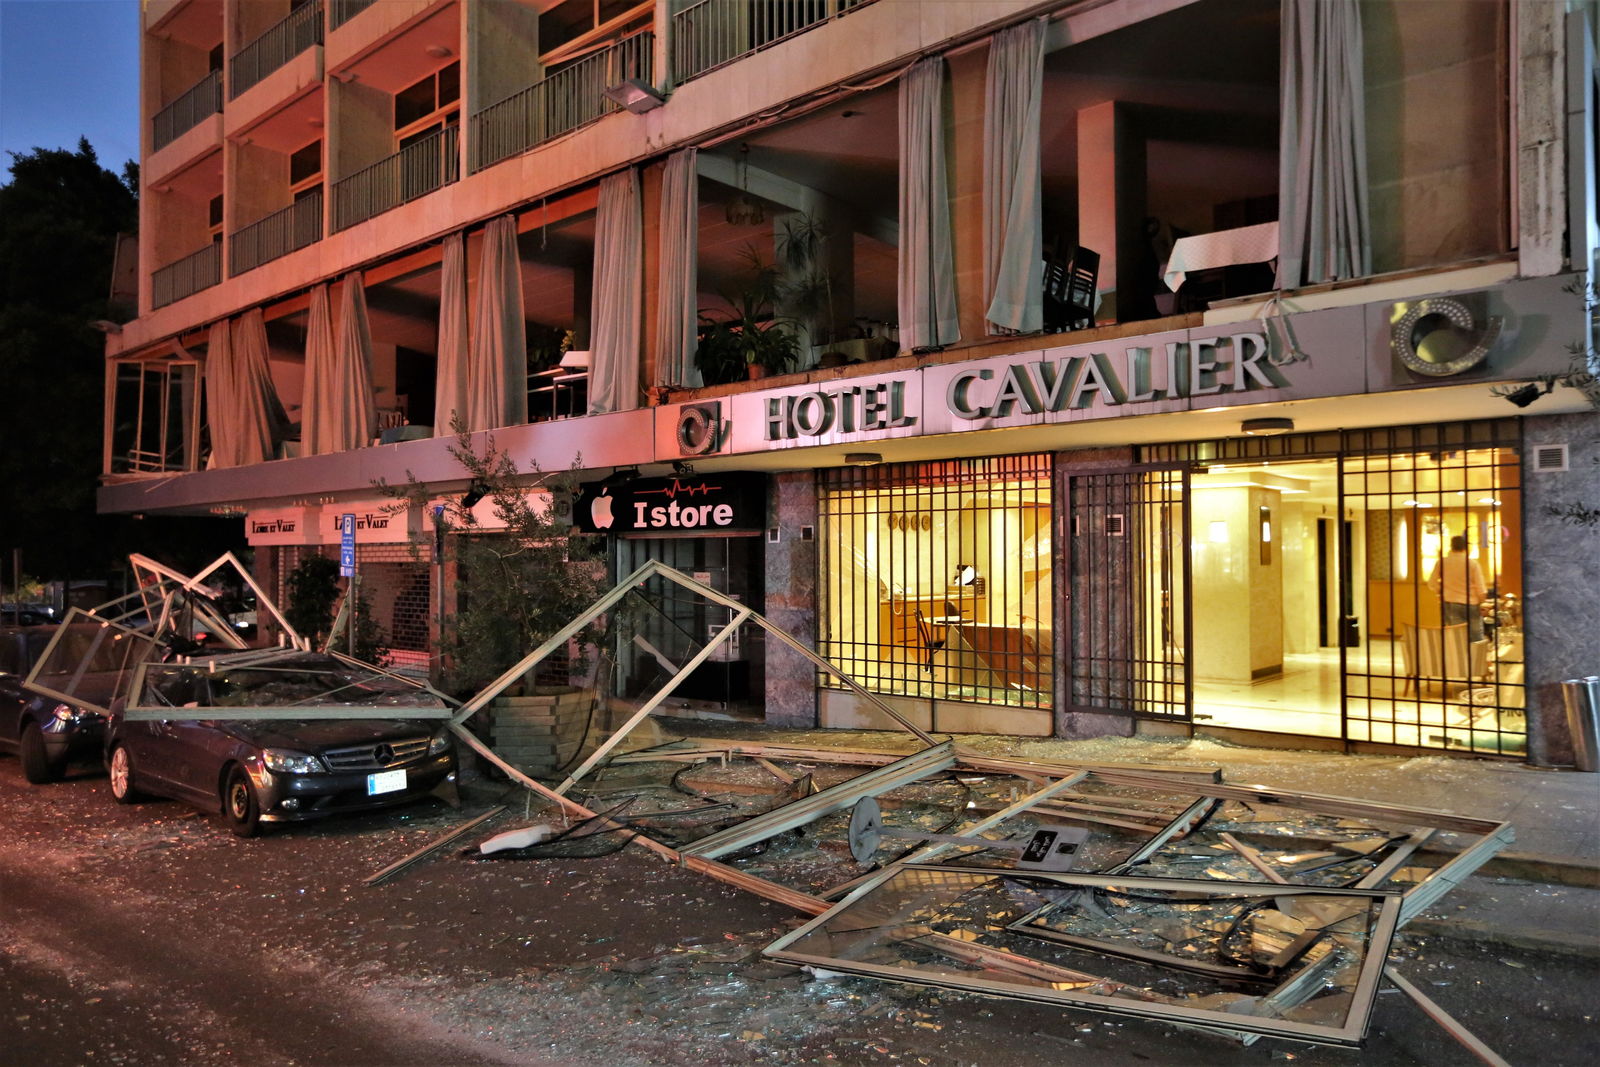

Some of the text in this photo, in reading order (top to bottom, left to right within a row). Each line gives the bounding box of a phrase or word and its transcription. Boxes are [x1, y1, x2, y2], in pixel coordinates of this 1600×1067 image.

[763, 332, 1287, 441] HOTEL CAVALIER
[633, 500, 733, 528] Istore
